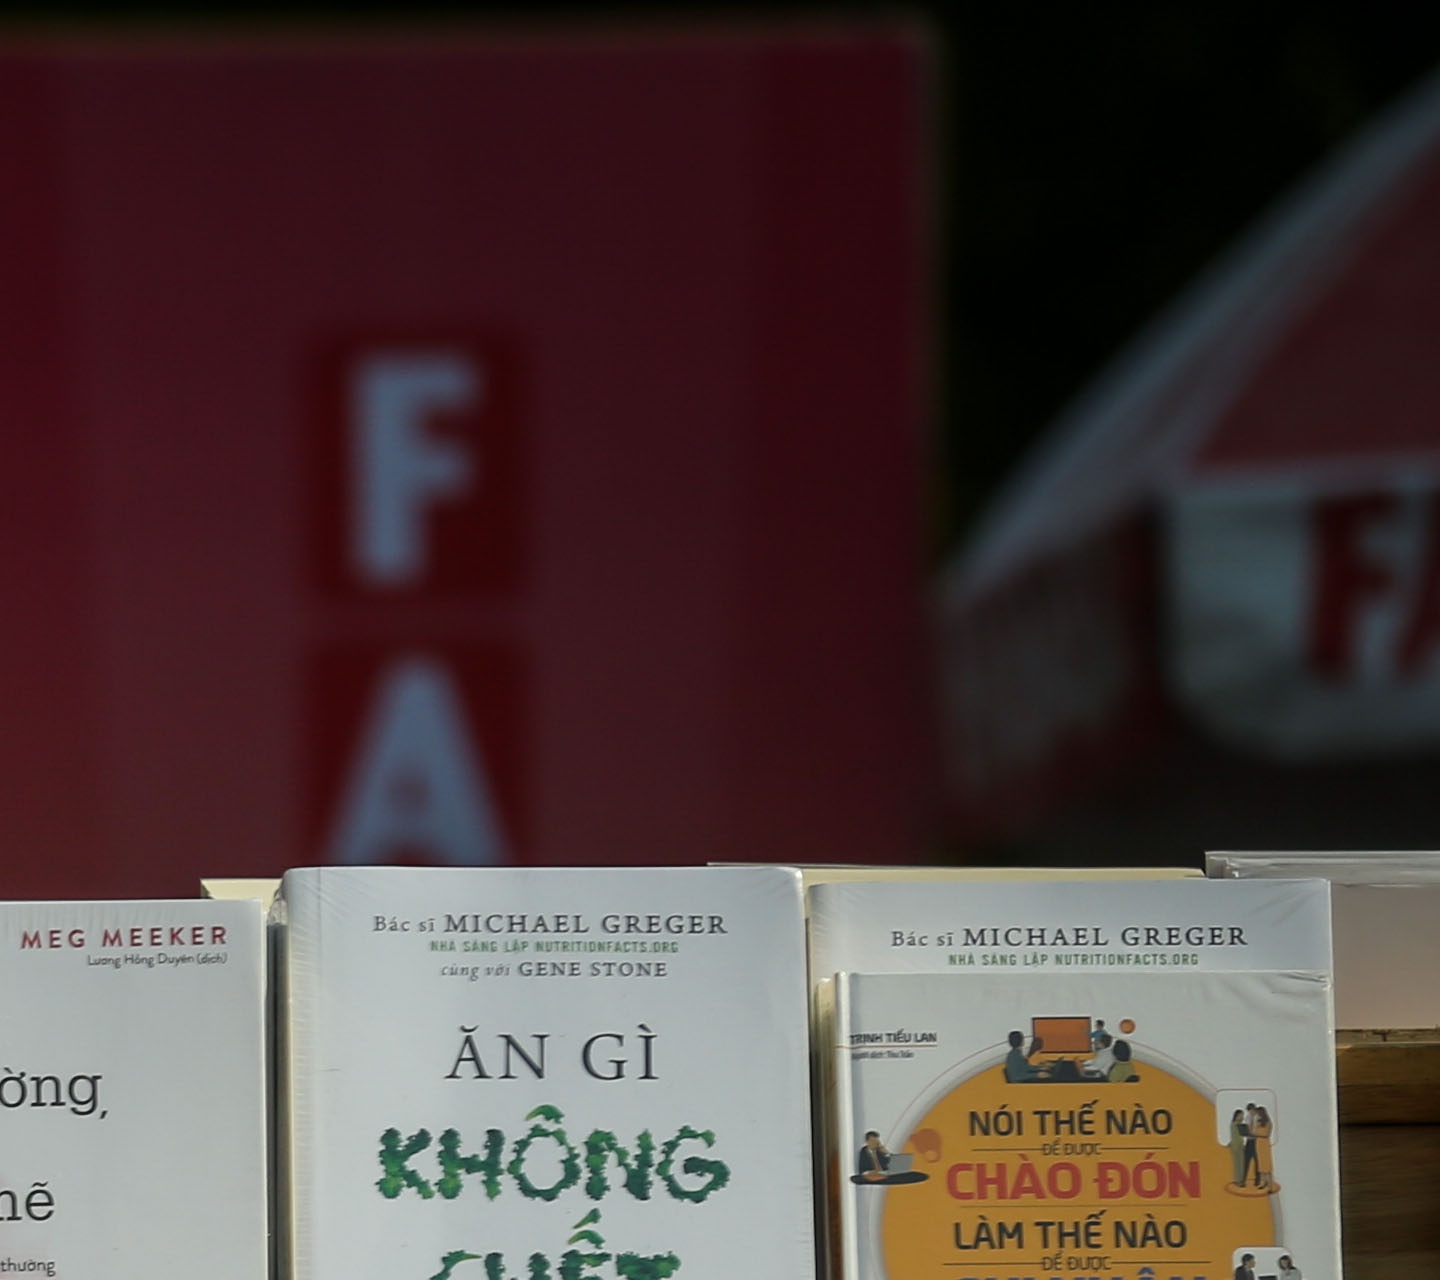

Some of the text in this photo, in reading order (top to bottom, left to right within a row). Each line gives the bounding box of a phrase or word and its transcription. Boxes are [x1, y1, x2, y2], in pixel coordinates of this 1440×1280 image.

[21, 926, 228, 949] MEG MEEKER
[444, 1024, 660, 1081] ĂN GÌ
[969, 1100, 1173, 1138] NÓI THẾ NÀO
[376, 1104, 731, 1203] KHÔNG
[946, 1148, 1202, 1201] CHÀO ĐÓN
[954, 1210, 1188, 1250] LÀM THẾ NÀO
